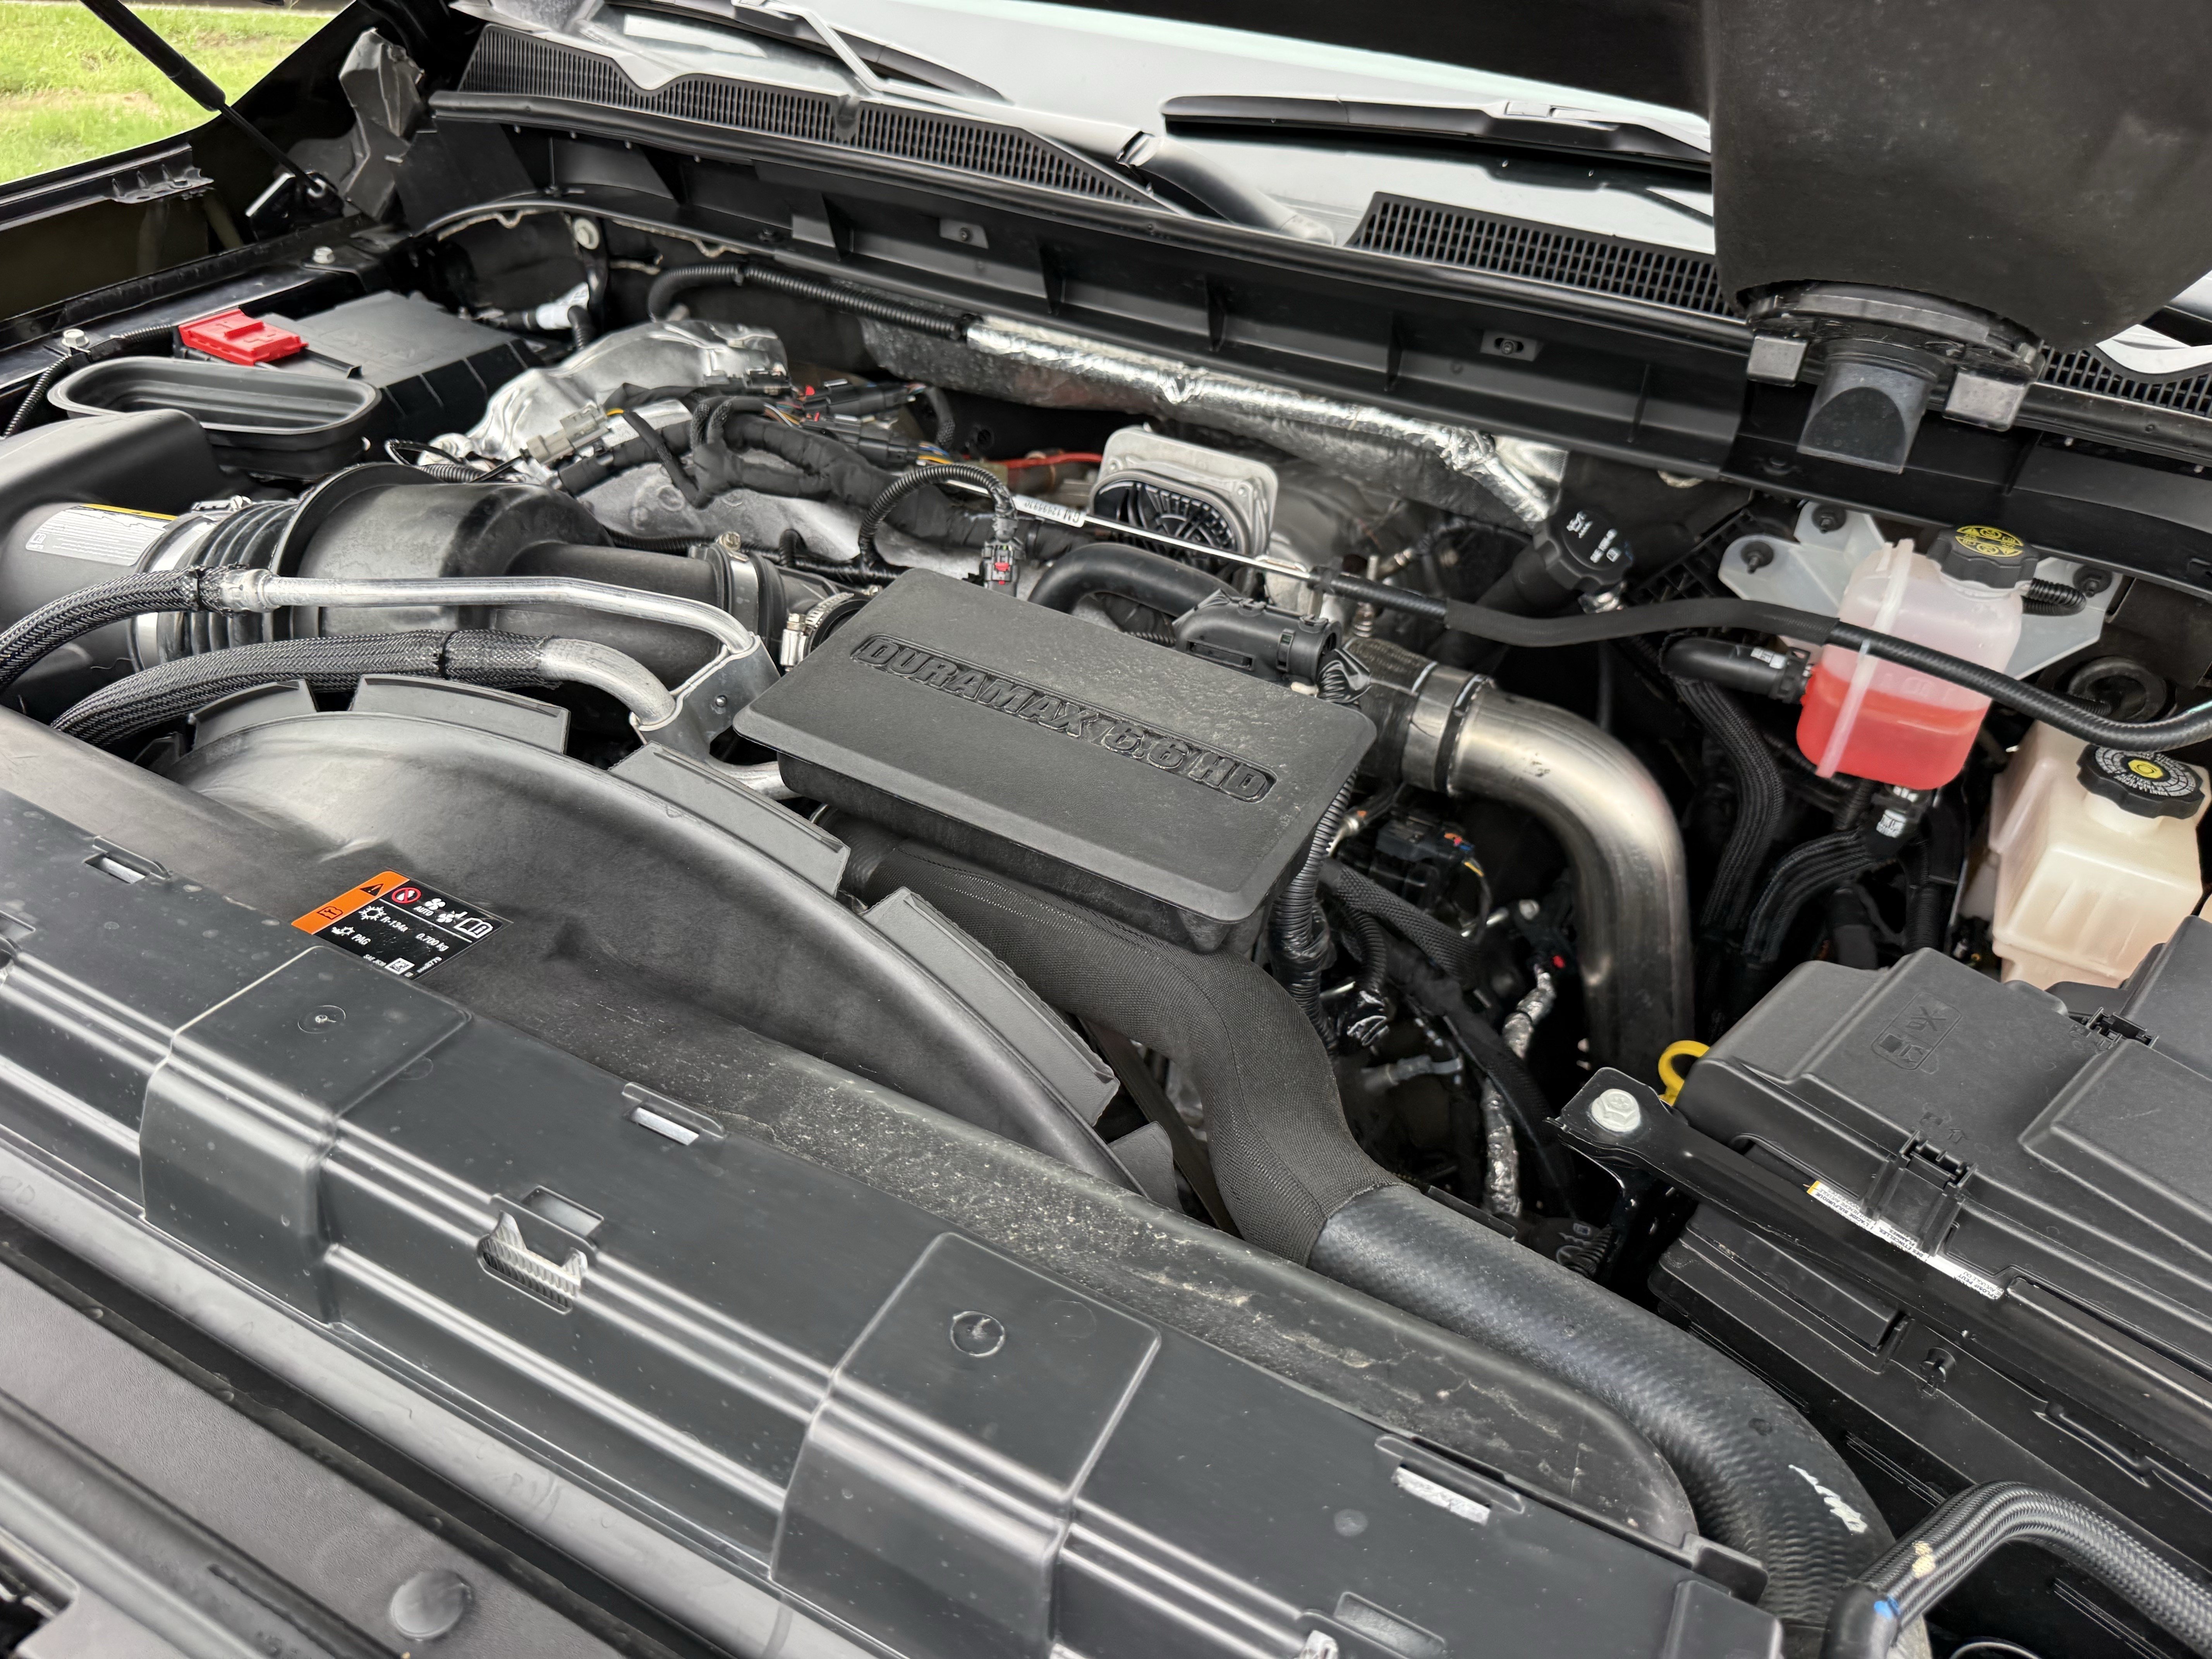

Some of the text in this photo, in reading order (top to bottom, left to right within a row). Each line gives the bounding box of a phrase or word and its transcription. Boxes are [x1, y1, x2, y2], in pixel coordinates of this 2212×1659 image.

[1063, 509, 1080, 523] GM
[857, 636, 1269, 803] DURAMAX 6.6 HD
[413, 906, 434, 916] AUTO
[351, 934, 371, 945] PAG
[380, 916, 449, 951] R-134a 0.700 kg
[1815, 1192, 1849, 1214] SULFURIQUE
[1848, 1212, 1869, 1227] L'ACIDE
[1958, 1274, 1973, 1285] PEUT
[1972, 1277, 1996, 1292] AVEUGLE
[1974, 1284, 1998, 1299] XPLOSIF
